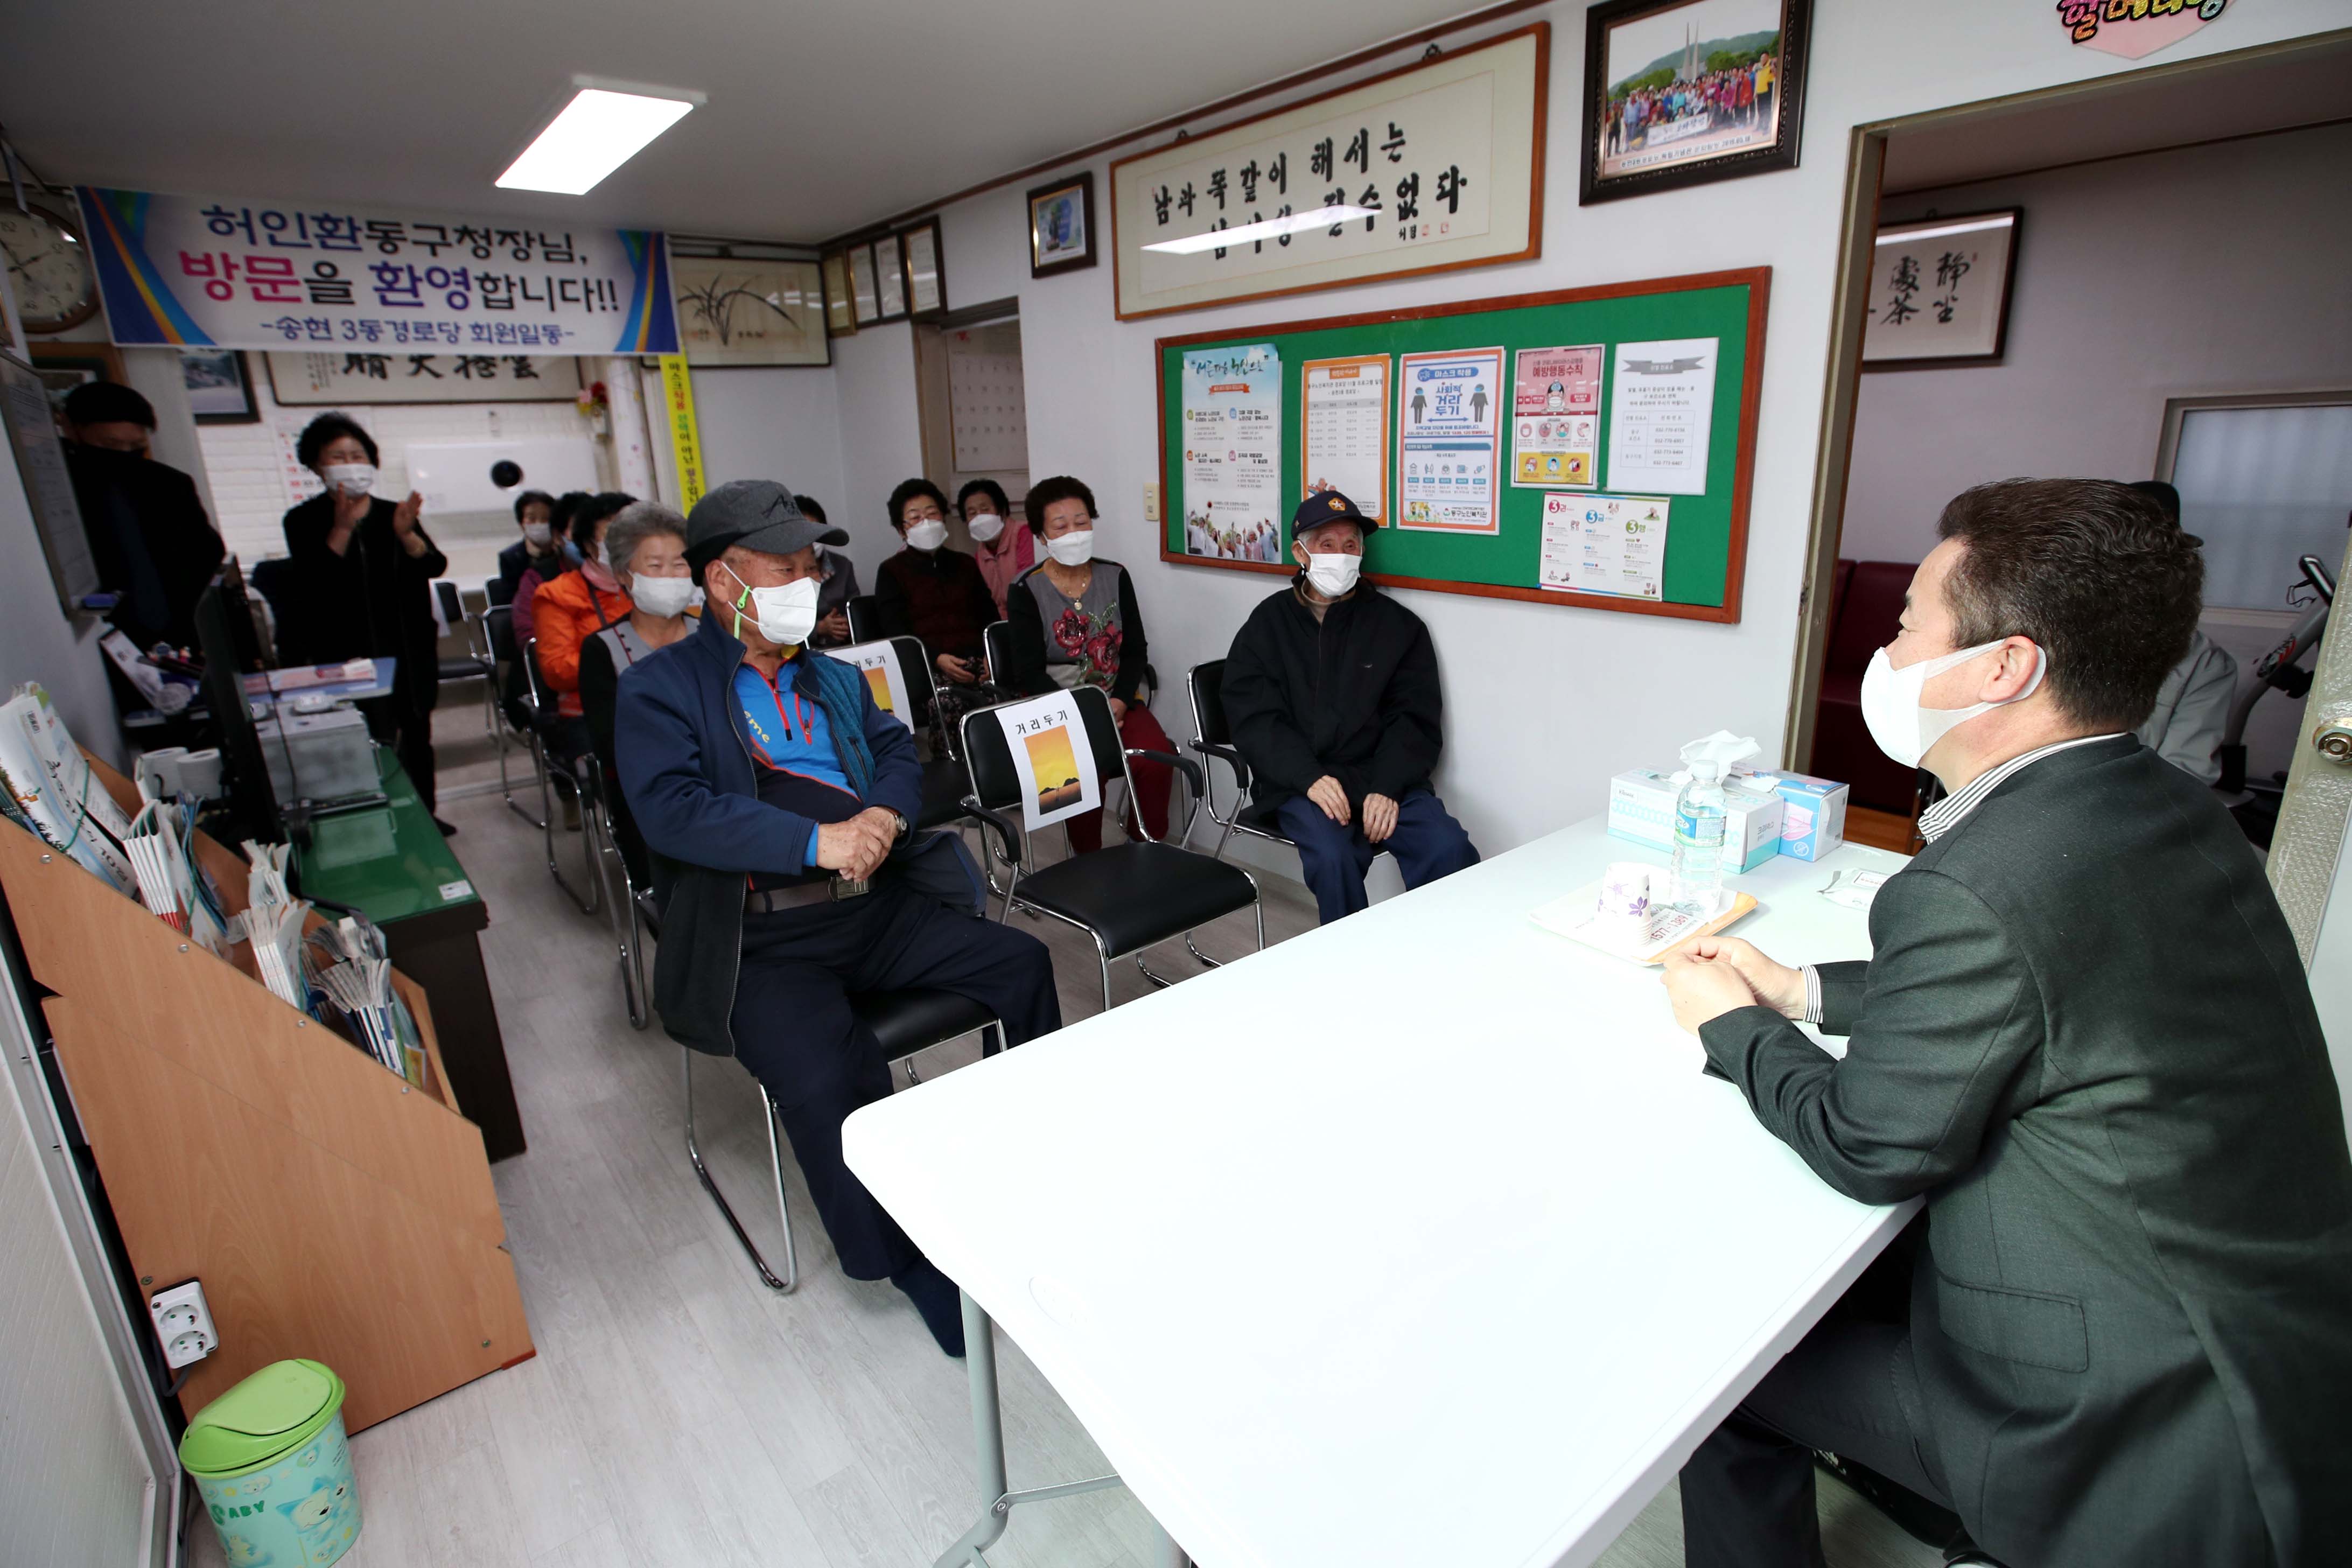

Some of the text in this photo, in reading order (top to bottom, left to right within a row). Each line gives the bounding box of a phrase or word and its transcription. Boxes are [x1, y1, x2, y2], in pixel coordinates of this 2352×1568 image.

[1153, 122, 1406, 227] 남과 똑같이 해서는
[201, 204, 590, 265] 허인환동구청장님,
[179, 249, 621, 314] 방문을 환영합니다!!
[1434, 369, 1456, 377] 마스크
[1533, 364, 1583, 377] 예방행동수칙
[1436, 382, 1463, 394] 사회적
[1436, 394, 1461, 405] 거리
[1436, 405, 1460, 416] 두기
[1451, 510, 1487, 518] 동구노인복지관
[1015, 710, 1068, 735] 거리두기
[210, 1500, 265, 1526] BABY
